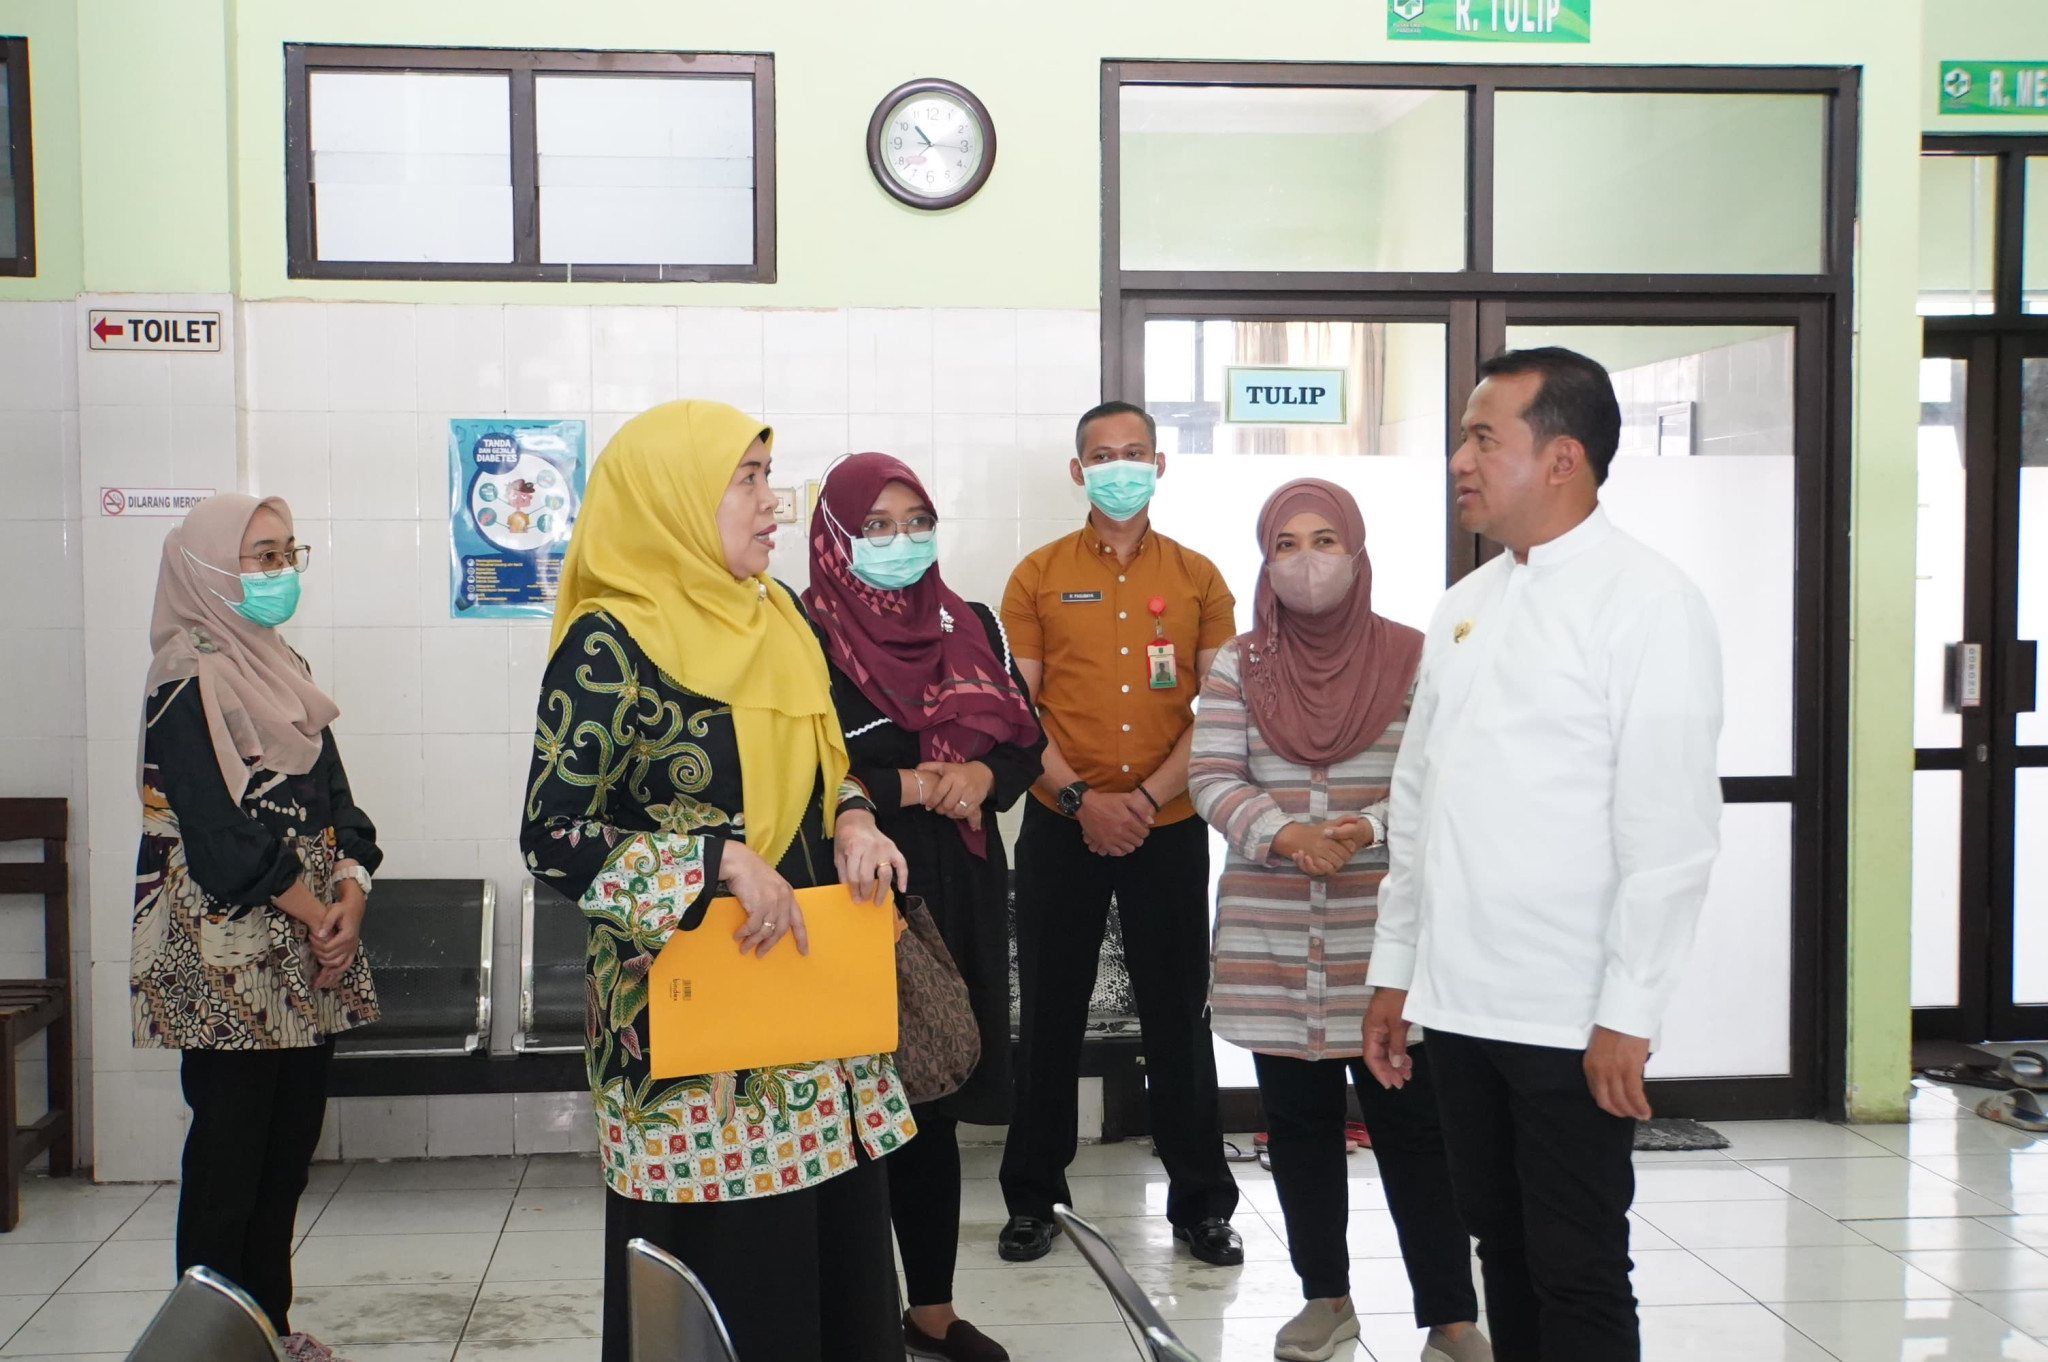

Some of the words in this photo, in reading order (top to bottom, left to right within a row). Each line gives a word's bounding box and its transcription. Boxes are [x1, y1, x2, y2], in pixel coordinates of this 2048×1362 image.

[1455, 0, 1478, 31] R.
[1489, 0, 1560, 33] TULIP
[1988, 69, 2010, 107] R.
[913, 111, 920, 119] 11
[926, 107, 939, 121] 12
[900, 122, 908, 131] 10
[957, 125, 964, 134] 2
[893, 136, 903, 150] 9
[960, 139, 969, 153] 3
[898, 156, 905, 165] 8
[956, 159, 963, 168] 4
[926, 170, 935, 183] 6
[127, 319, 217, 343] TOILET
[1245, 386, 1326, 405] TULIP
[482, 439, 511, 447] TANDA
[476, 454, 518, 462] DIABETES
[128, 496, 171, 508] DILARANG
